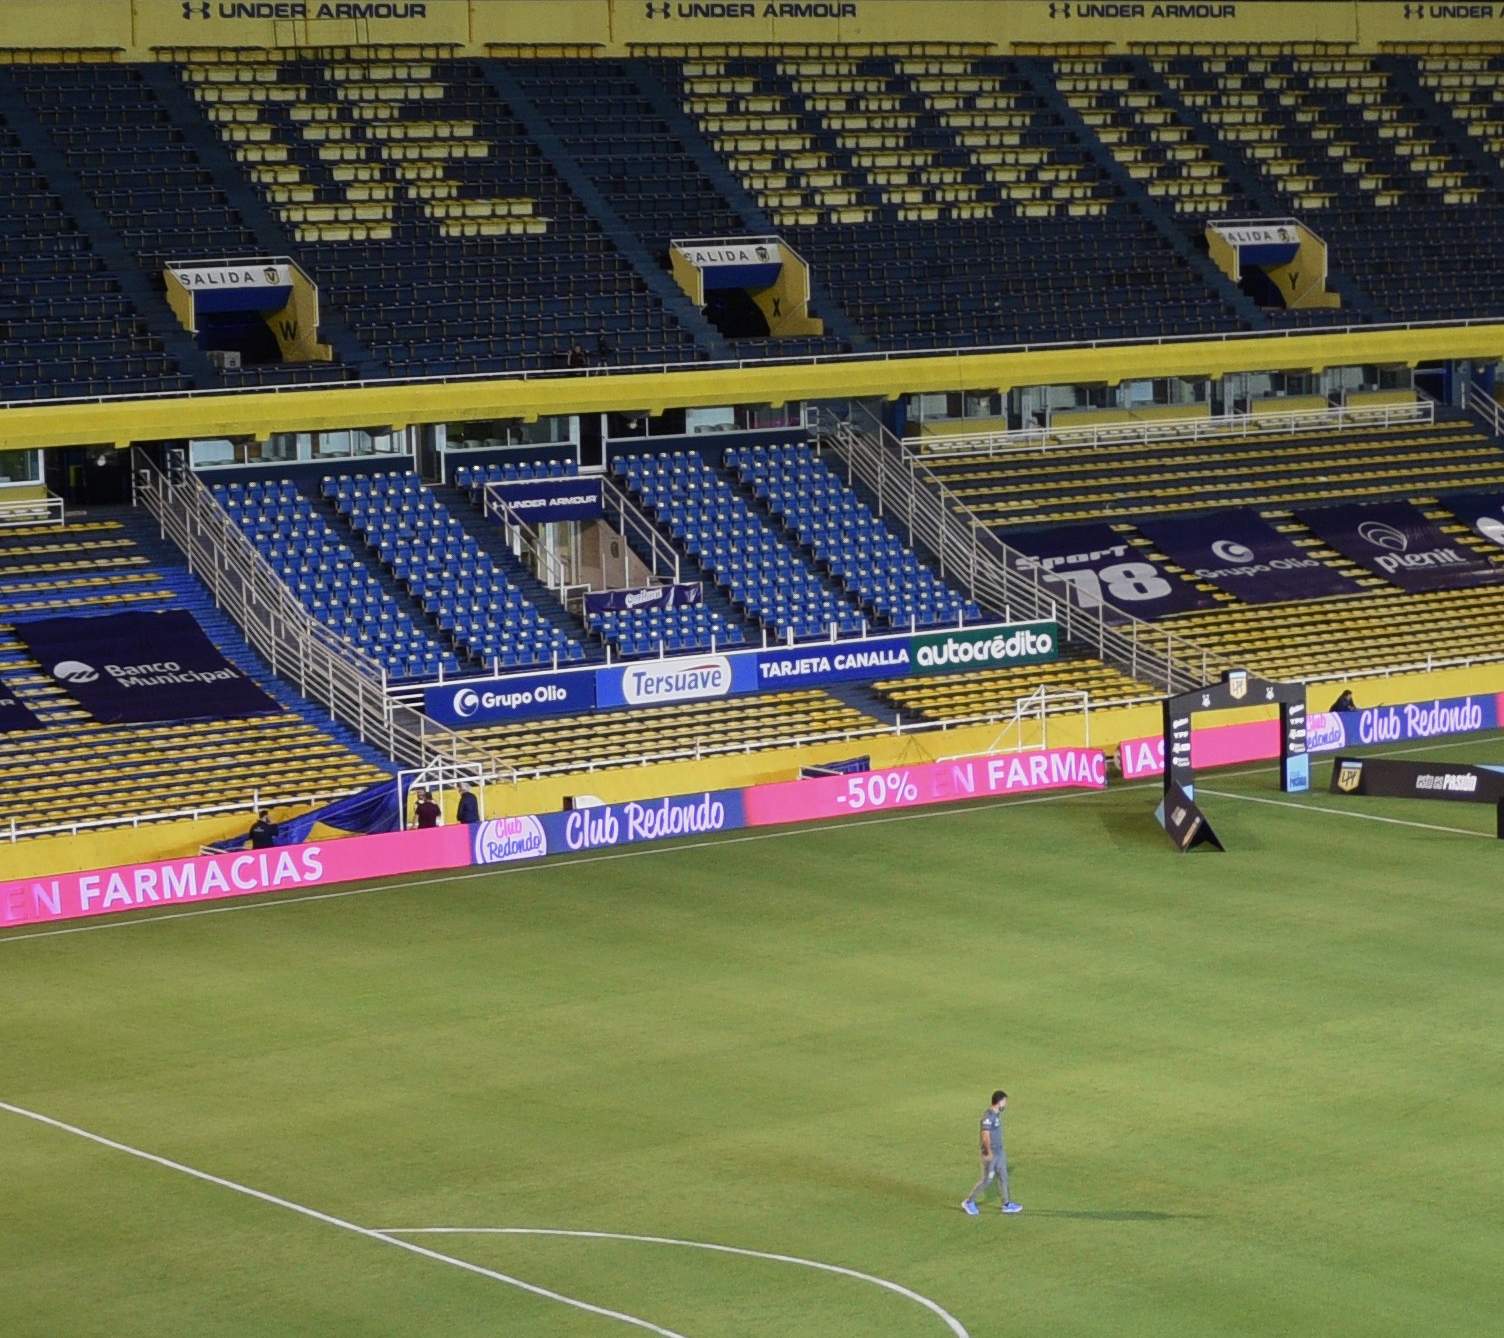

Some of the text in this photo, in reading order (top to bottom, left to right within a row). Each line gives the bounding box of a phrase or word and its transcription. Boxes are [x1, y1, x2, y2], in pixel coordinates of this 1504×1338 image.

[219, 3, 427, 19] UNDER ARMOUR
[677, 3, 857, 18] UNDER ARMOUR
[1076, 4, 1236, 18] UNDER ARMOUR
[1429, 5, 1494, 19] UNDER
[180, 270, 256, 286] SALIDA
[1289, 273, 1299, 291] Y
[773, 299, 781, 317] X
[279, 322, 296, 342] W
[508, 494, 597, 509] UNDER ARMOUR
[1016, 545, 1128, 571] Sport
[1374, 548, 1467, 574] plenit
[1042, 562, 1173, 608] 78
[916, 629, 1052, 664] autocrédito
[104, 661, 181, 678] Banco
[760, 647, 910, 679] TARJETA CANALLA
[120, 667, 240, 688] Municipal
[632, 667, 722, 696] Tersuave
[482, 686, 567, 711] Grupo Olio
[1359, 697, 1482, 746] Club Redondo
[1307, 729, 1342, 750] edondo
[836, 771, 918, 809] -50%
[495, 817, 522, 839] Club
[566, 793, 725, 849] Club Redondo
[486, 833, 541, 861] Redondo
[80, 846, 324, 912] FARMACIAS
